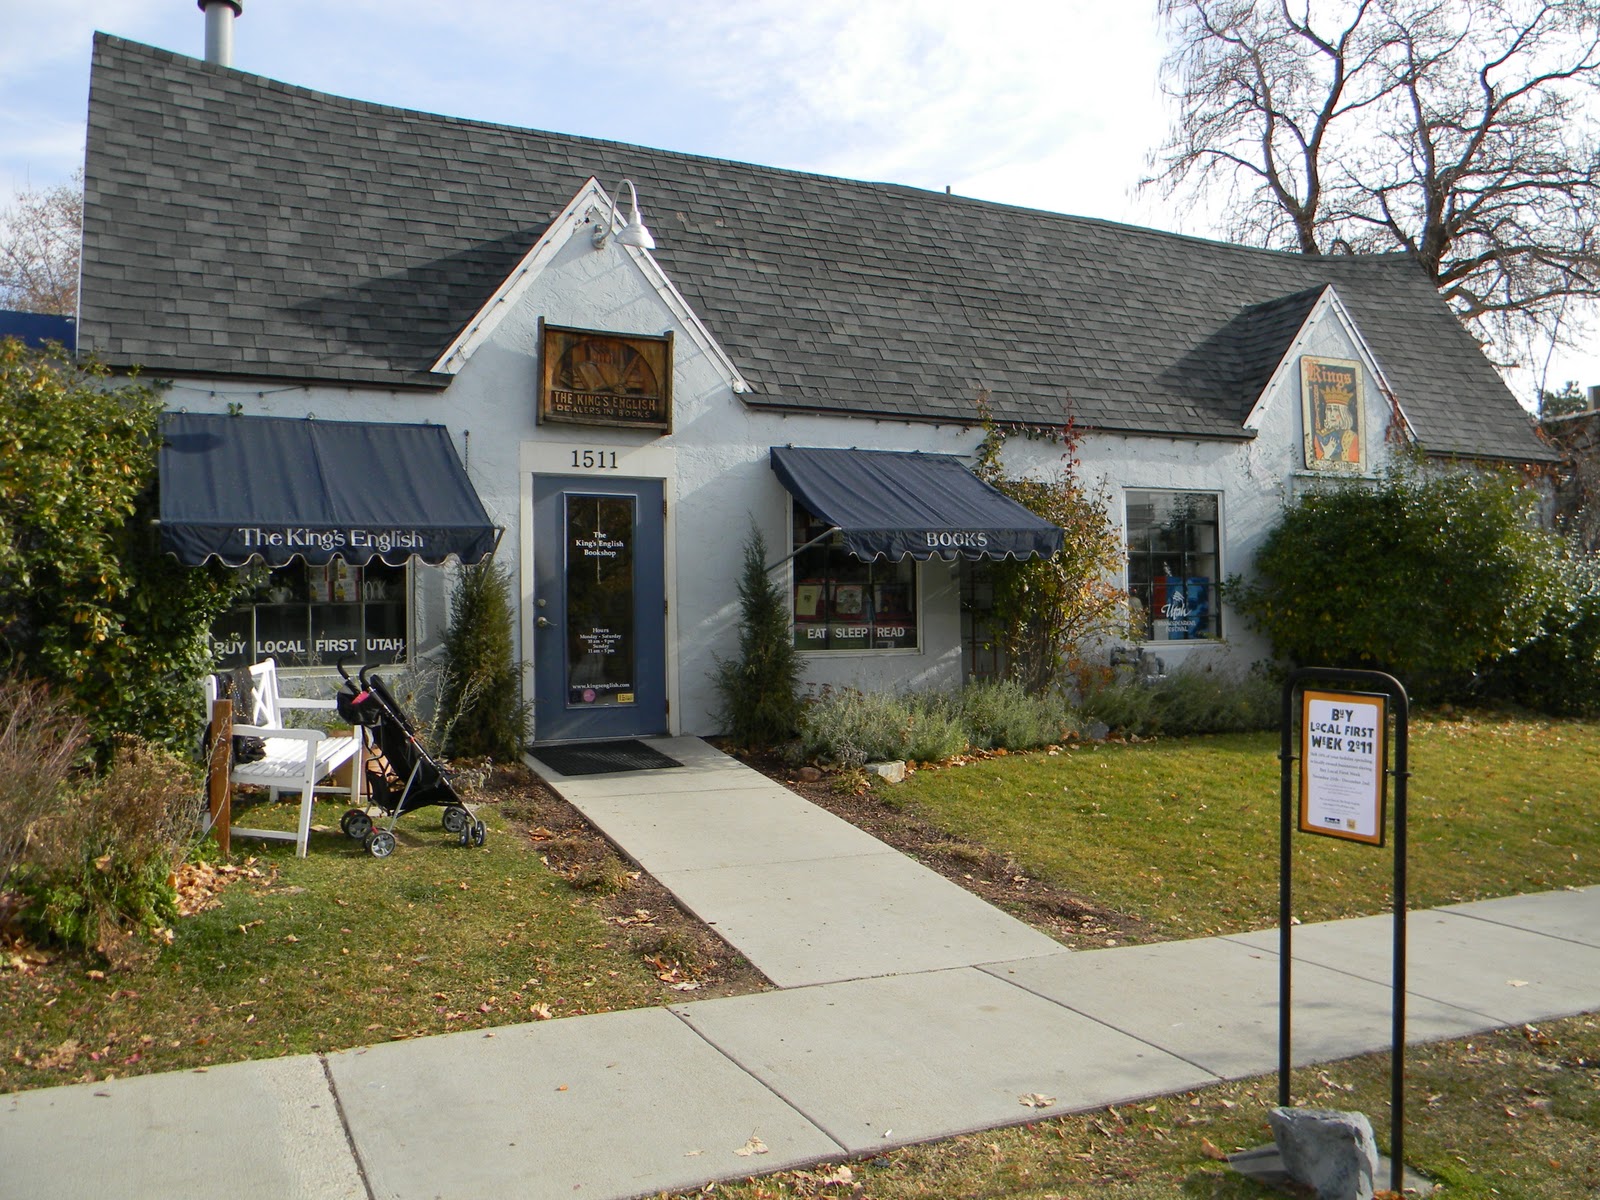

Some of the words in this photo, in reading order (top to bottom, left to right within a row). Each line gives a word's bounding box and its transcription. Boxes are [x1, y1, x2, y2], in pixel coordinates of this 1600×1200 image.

[554, 391, 573, 405] THE
[577, 394, 609, 408] KING'S
[612, 397, 657, 411] ENGLISH
[556, 405, 601, 415] DEALERS
[603, 408, 614, 416] IN
[618, 409, 651, 419] BOOKS
[571, 450, 618, 469] 1511
[238, 528, 283, 546] The
[287, 528, 346, 551] King's
[350, 530, 424, 552] English
[593, 531, 607, 539] The
[926, 532, 988, 547] BOOKS
[575, 539, 597, 549] King's
[598, 540, 624, 549] English
[583, 549, 617, 558] Bookshop
[1160, 603, 1192, 620] Utah
[807, 628, 827, 639] EAT
[835, 627, 868, 638] SLEEP
[876, 626, 905, 638] READ
[213, 641, 247, 655] BUY
[256, 640, 306, 654] LOCAL
[315, 639, 357, 652] FIRST
[366, 638, 403, 651] UTAH
[571, 683, 630, 691] www.kingsenglish.com
[1331, 708, 1354, 723] BUY
[1310, 722, 1342, 735] LOCAL
[1344, 725, 1374, 738] FIRST
[1311, 735, 1343, 751] WEEK
[1346, 739, 1373, 755] 2011
